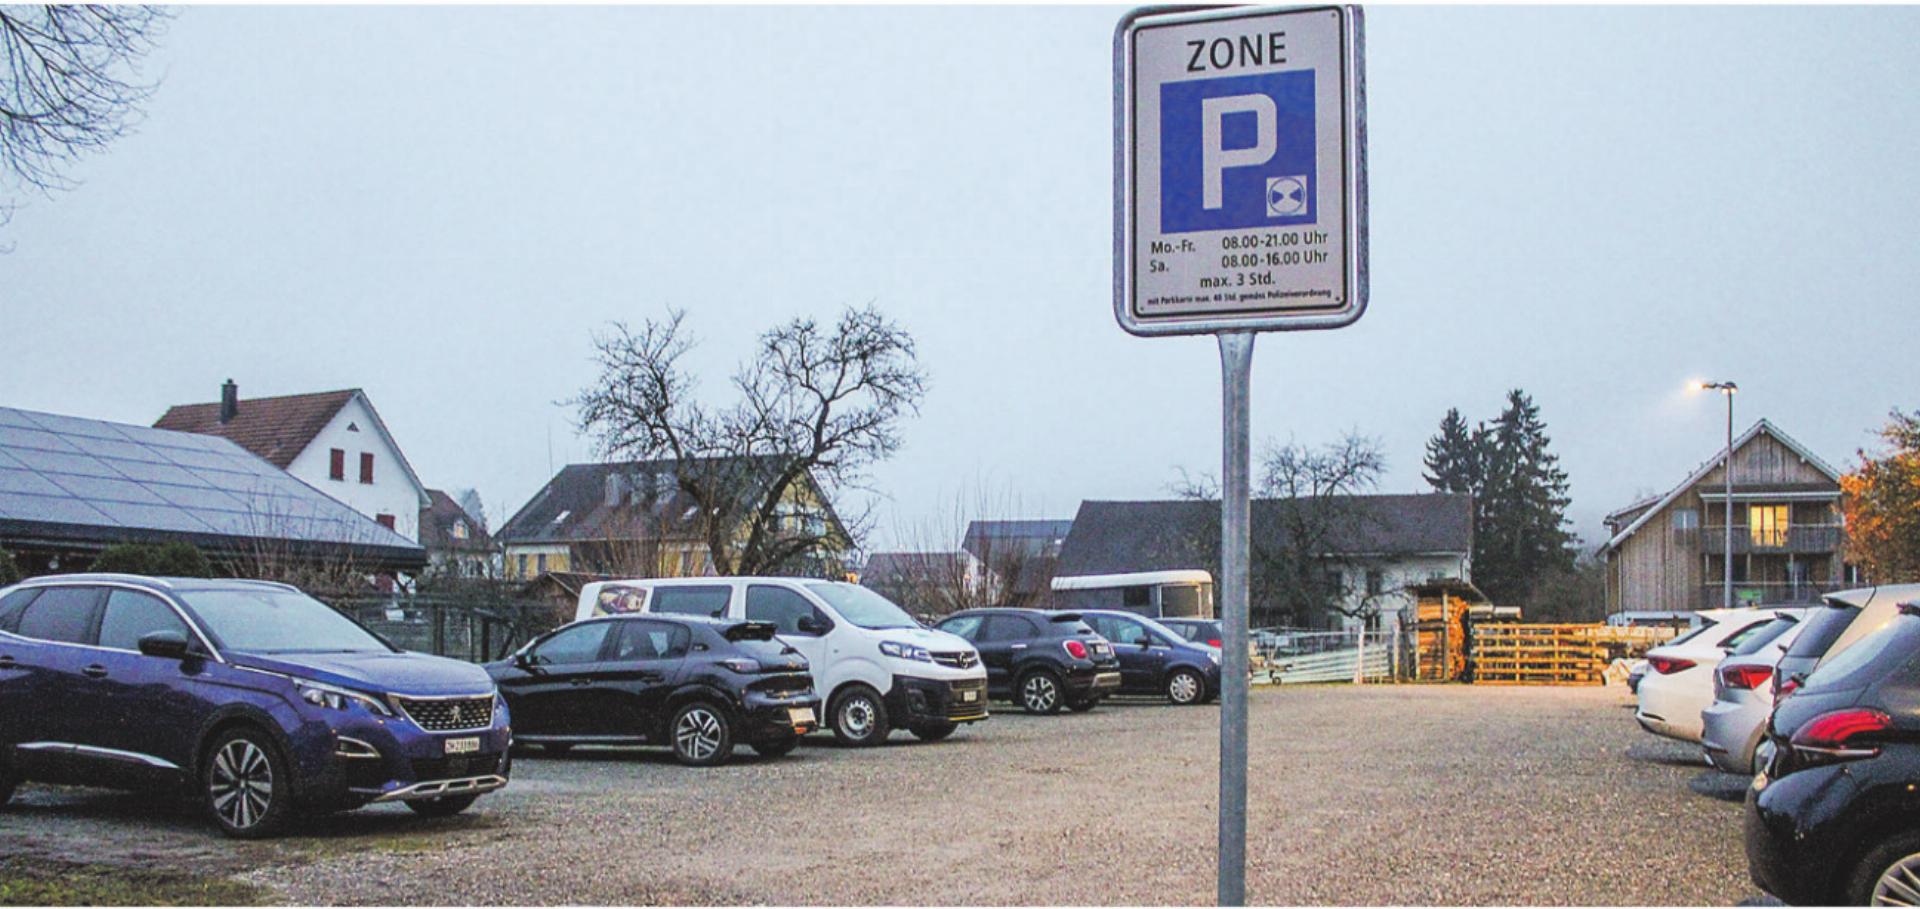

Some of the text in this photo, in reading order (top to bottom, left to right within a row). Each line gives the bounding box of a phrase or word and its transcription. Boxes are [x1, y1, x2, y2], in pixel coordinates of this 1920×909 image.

[1187, 32, 1287, 72] ZONE
[1202, 93, 1277, 210] P
[1151, 230, 1329, 255] Mo.-Fr. 08.00-21.00 Uhr
[1150, 250, 1329, 273] Sa. 08.00-16.00 Uhr
[1200, 270, 1276, 288] max. 3 Std.
